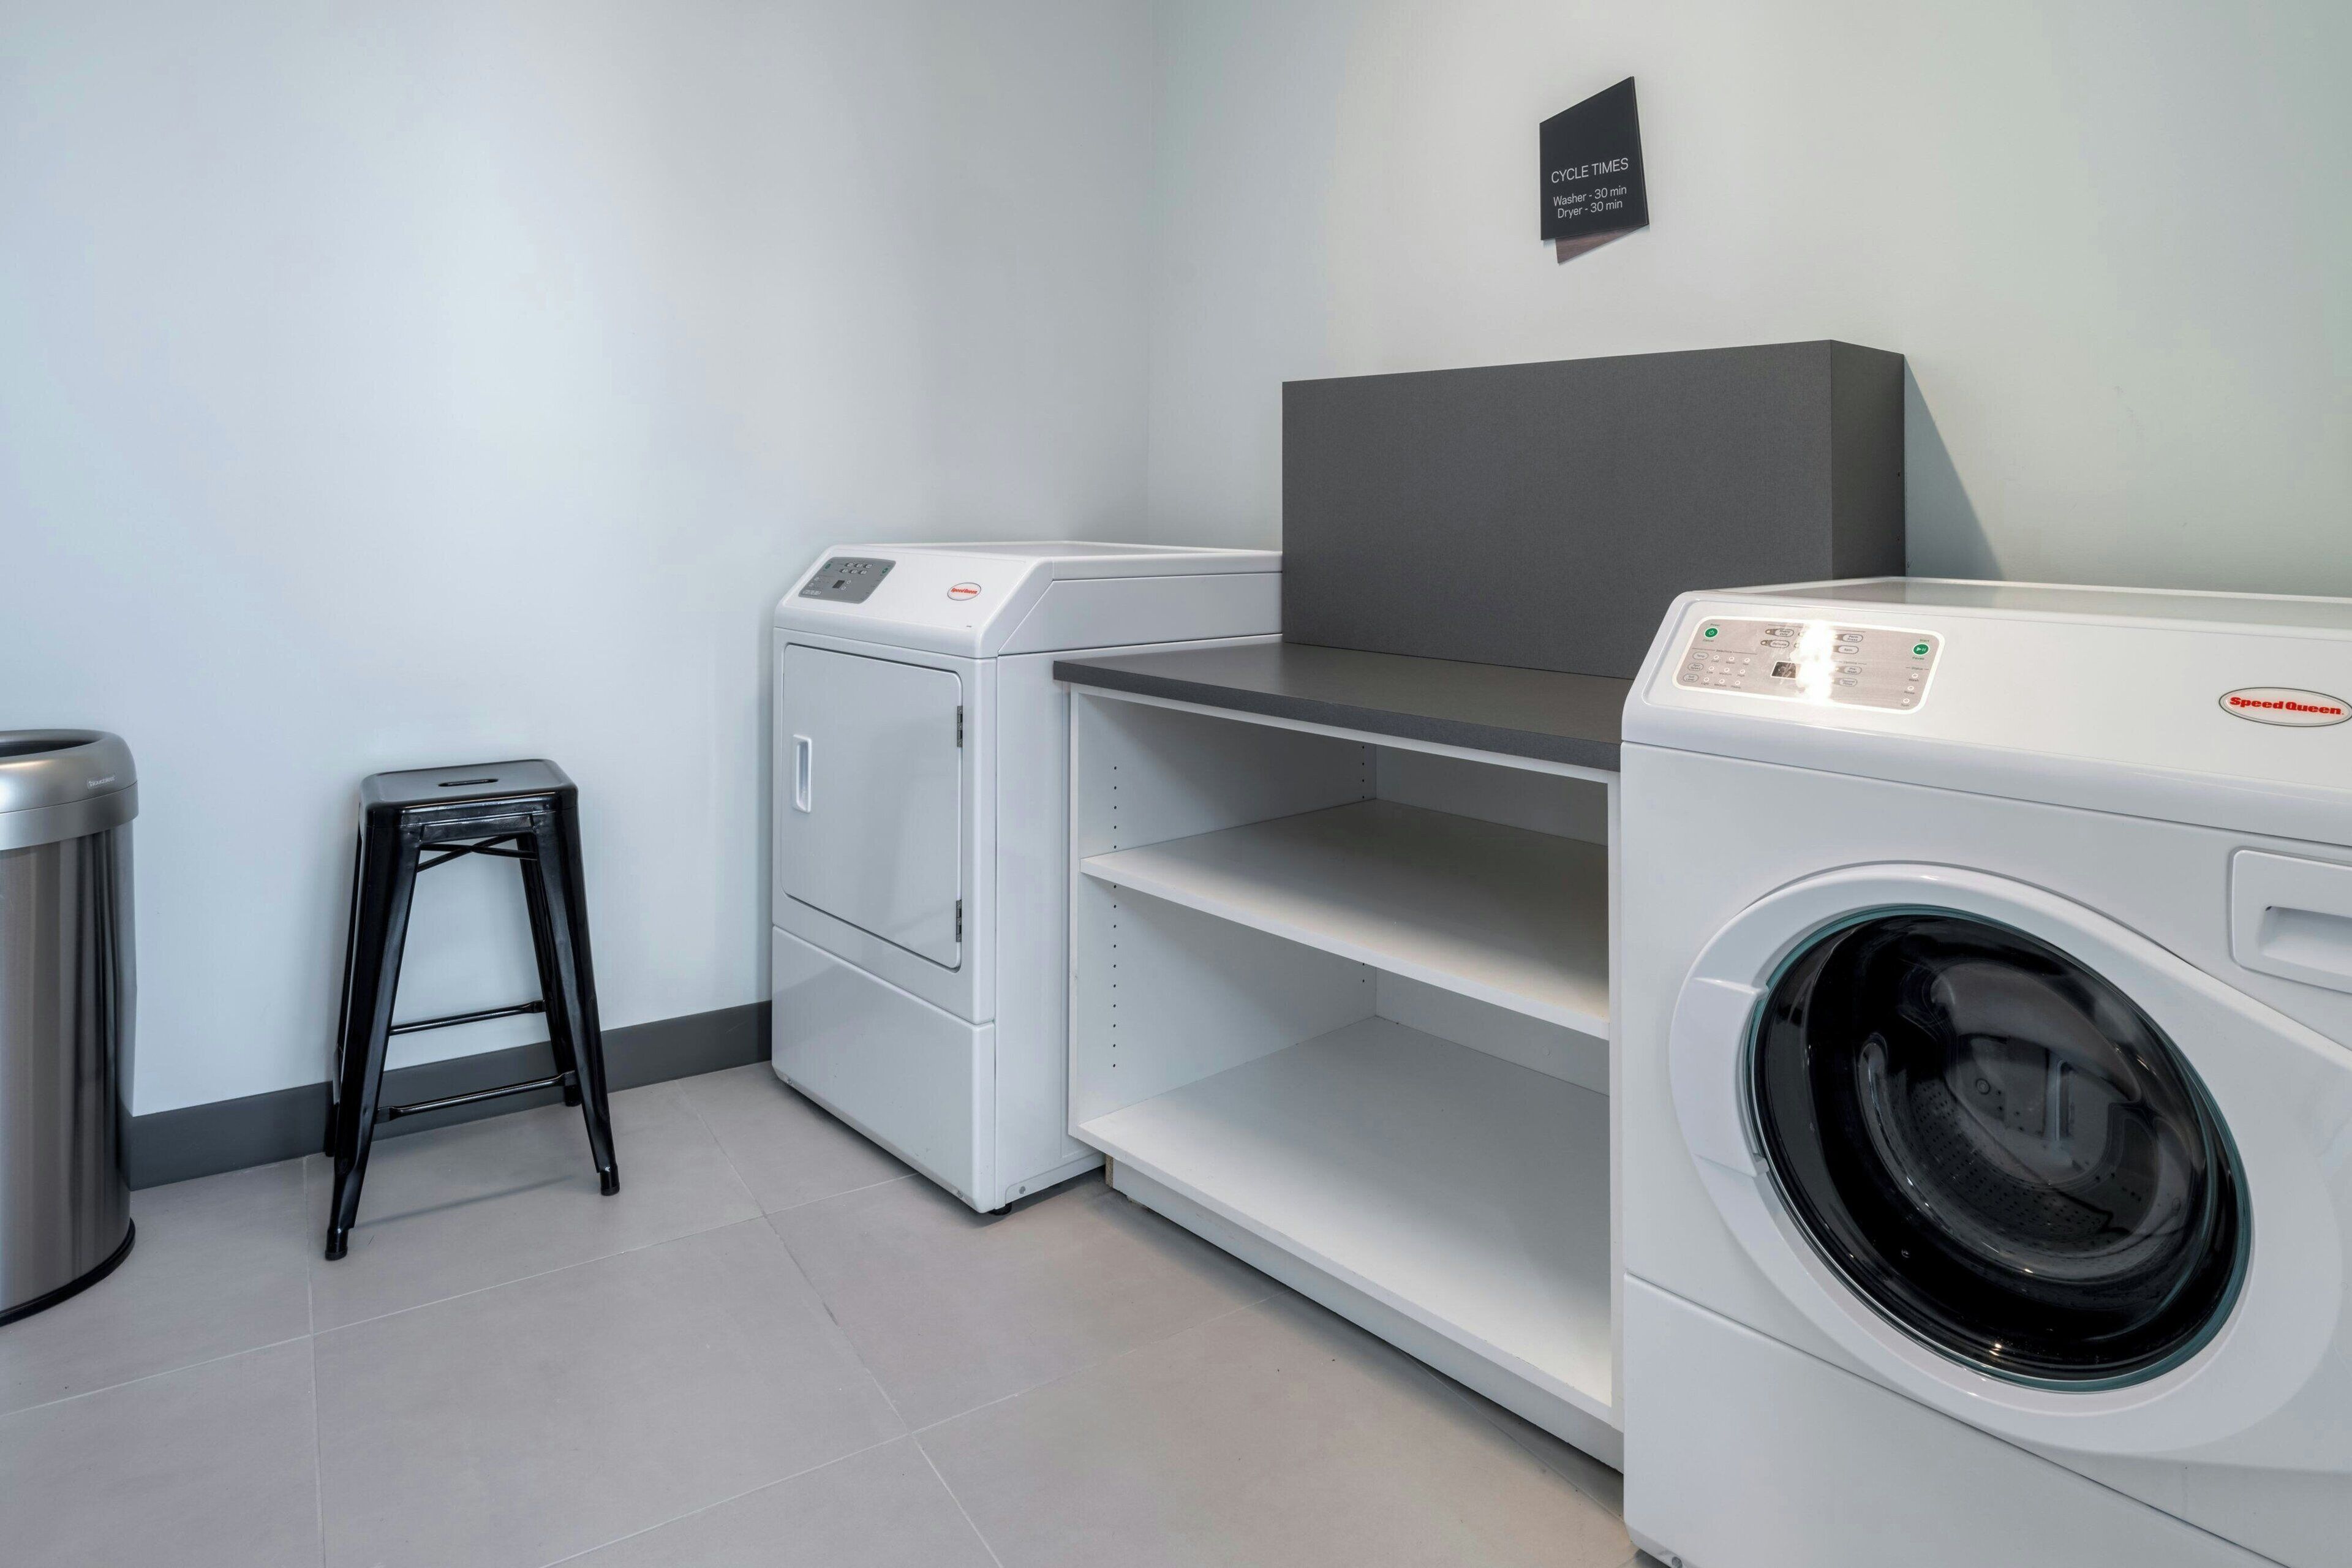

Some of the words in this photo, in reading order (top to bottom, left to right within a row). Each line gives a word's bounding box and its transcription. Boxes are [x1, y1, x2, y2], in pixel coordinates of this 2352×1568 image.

[1551, 165, 1589, 183] CYCLE
[1591, 157, 1629, 176] TIMES
[1553, 193, 1587, 206] Washer
[1594, 187, 1608, 199] 30
[1610, 185, 1627, 197] min
[1558, 207, 1583, 219] Dryer
[1590, 201, 1604, 213] 30
[1606, 199, 1623, 210] min
[2230, 696, 2284, 709] Speed
[2285, 702, 2342, 715] Queen
